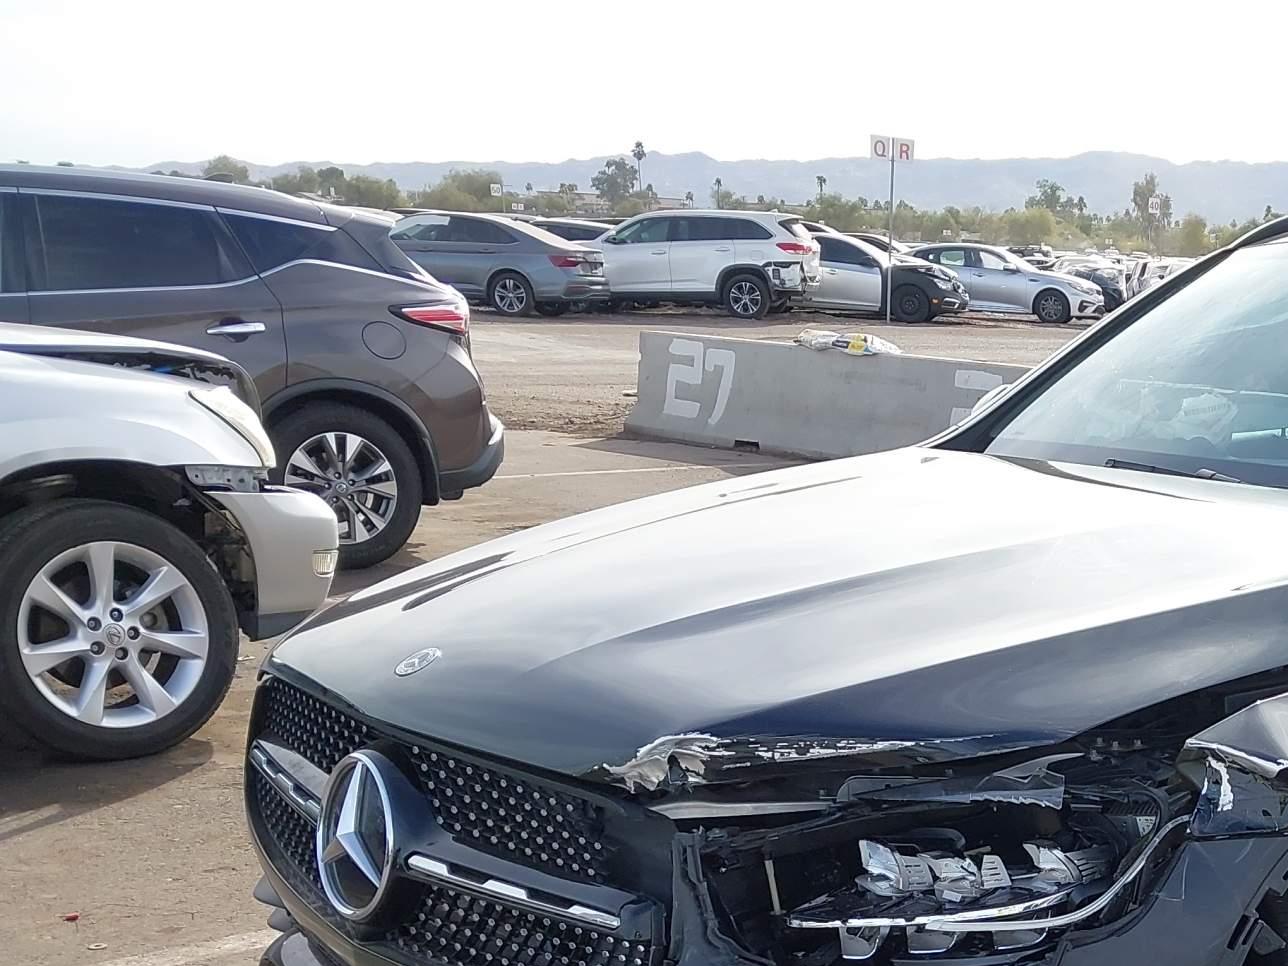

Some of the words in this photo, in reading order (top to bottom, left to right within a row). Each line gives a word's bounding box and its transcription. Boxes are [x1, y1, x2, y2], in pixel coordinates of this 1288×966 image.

[874, 140, 887, 157] Q
[899, 143, 910, 160] R
[1150, 201, 1159, 210] 40
[664, 338, 735, 425] 27
